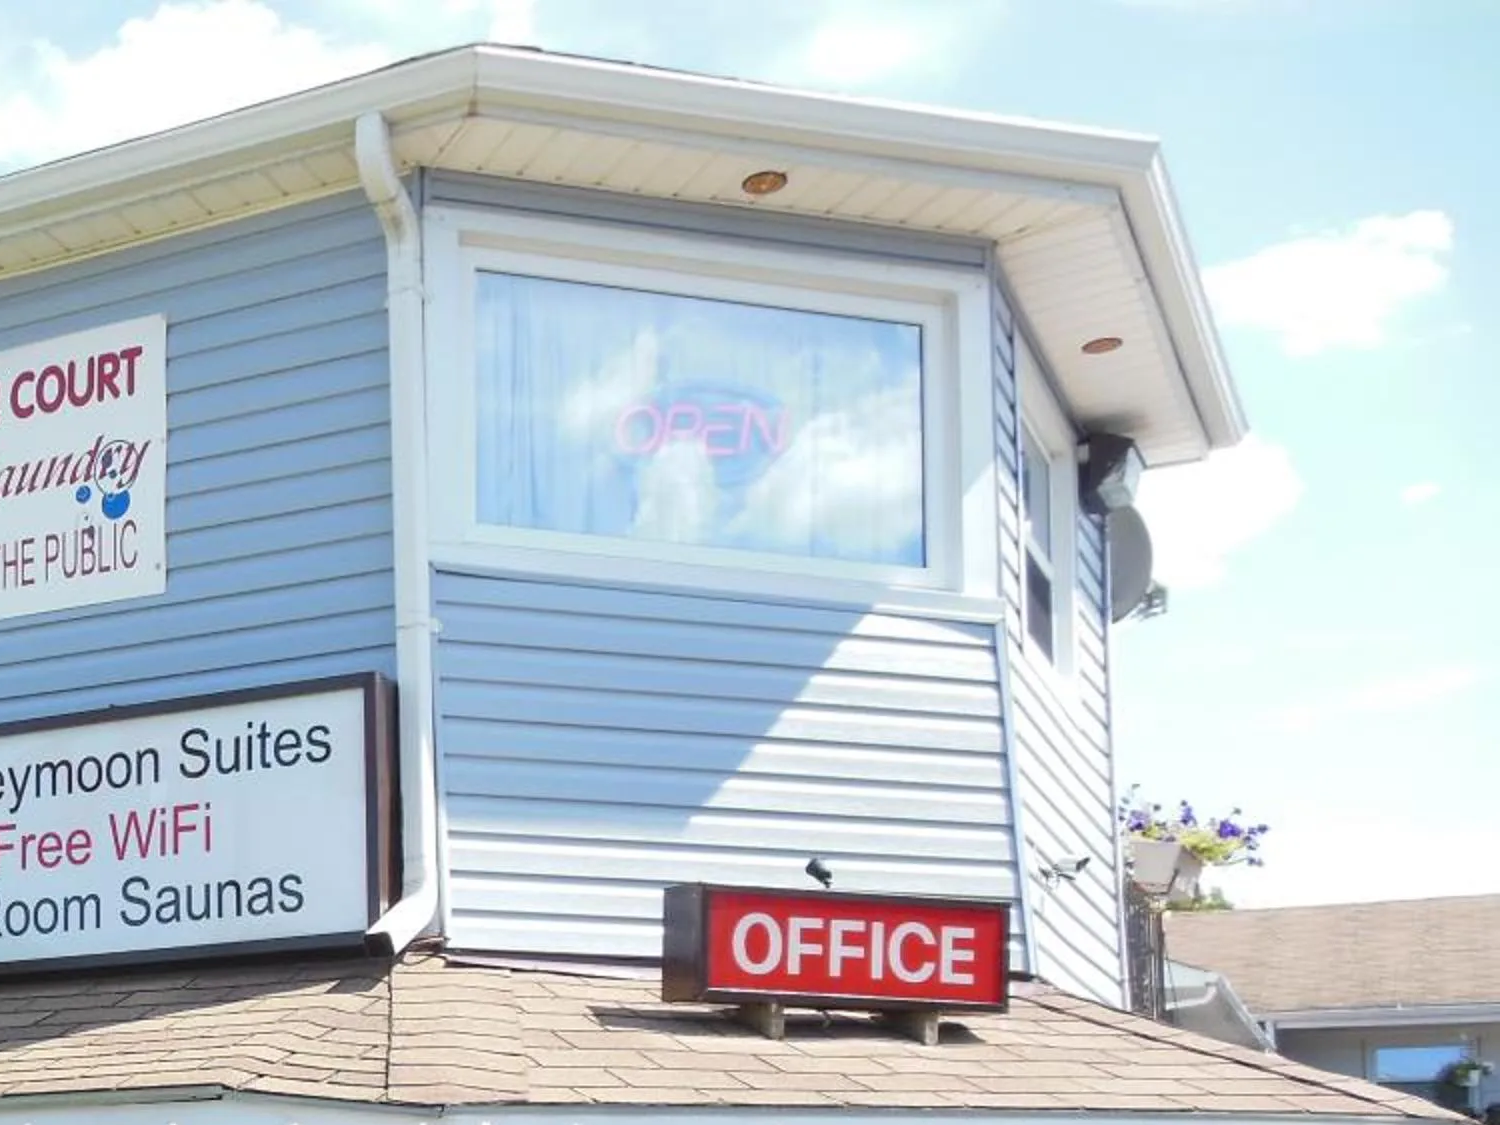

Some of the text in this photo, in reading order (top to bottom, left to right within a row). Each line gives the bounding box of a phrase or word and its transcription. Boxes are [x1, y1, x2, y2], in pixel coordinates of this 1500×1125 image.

[10, 346, 143, 418] COURT
[614, 400, 789, 458] OPEN
[45, 519, 138, 583] PUBLIC
[179, 721, 332, 779] Suites
[109, 802, 213, 861] WiFi
[120, 873, 305, 928] Saunas
[731, 912, 976, 985] OFFICE
